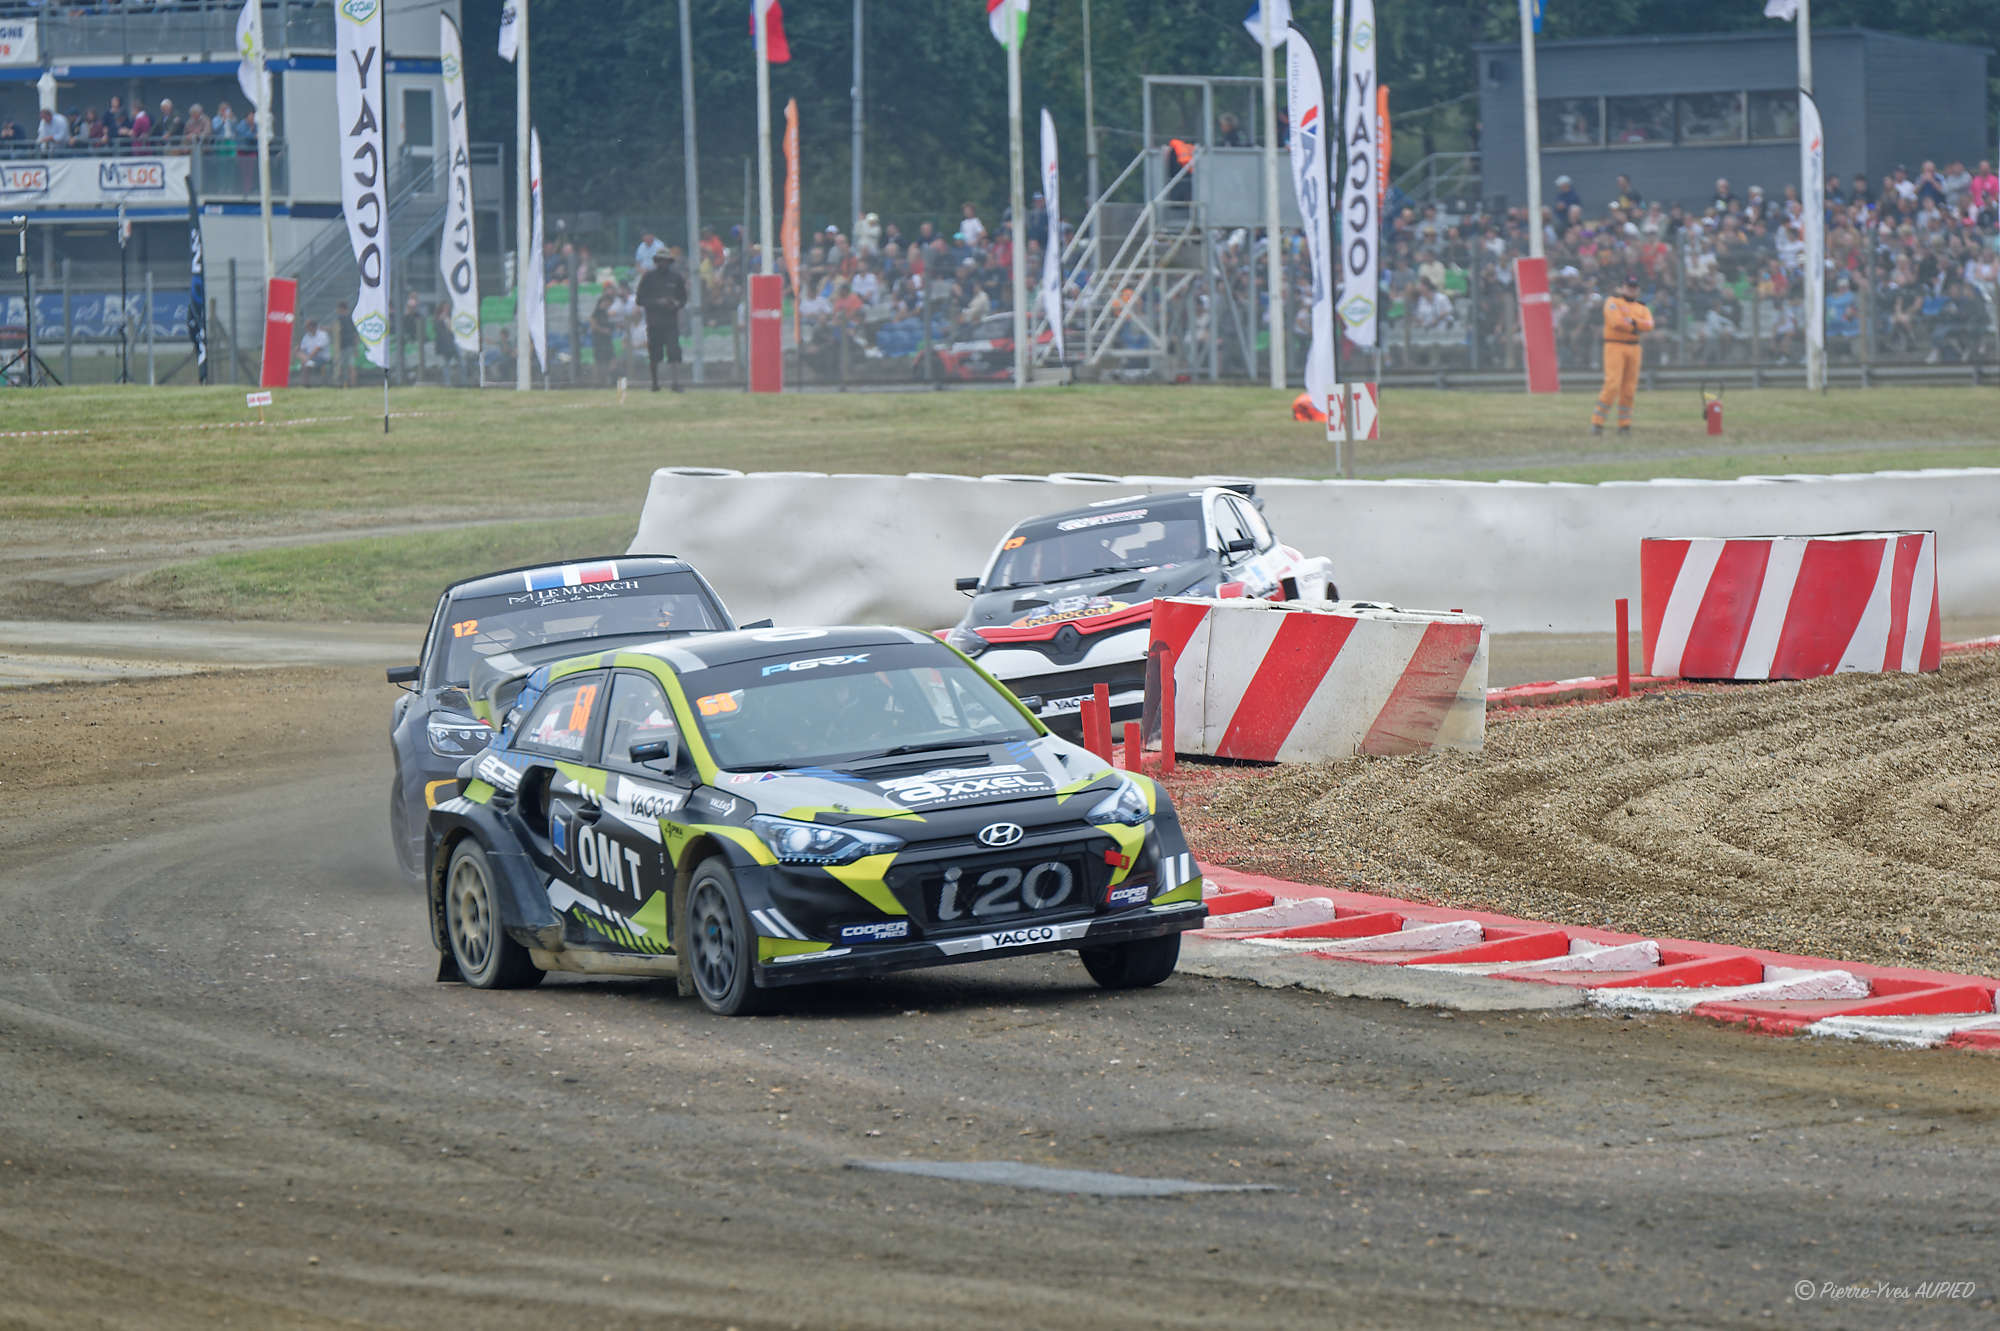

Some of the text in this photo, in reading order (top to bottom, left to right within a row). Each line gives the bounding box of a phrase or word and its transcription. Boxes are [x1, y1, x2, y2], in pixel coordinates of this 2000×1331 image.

[1327, 393, 1361, 432] EXT
[563, 580, 640, 596] MANACH
[452, 620, 479, 638] 12
[568, 684, 597, 732] 68
[696, 692, 738, 716] 68
[935, 786, 1052, 804] MANUTENTION
[578, 825, 642, 901] OMT
[938, 862, 1073, 921] i20
[842, 921, 908, 937] COOPER
[992, 927, 1053, 946] YACCO
